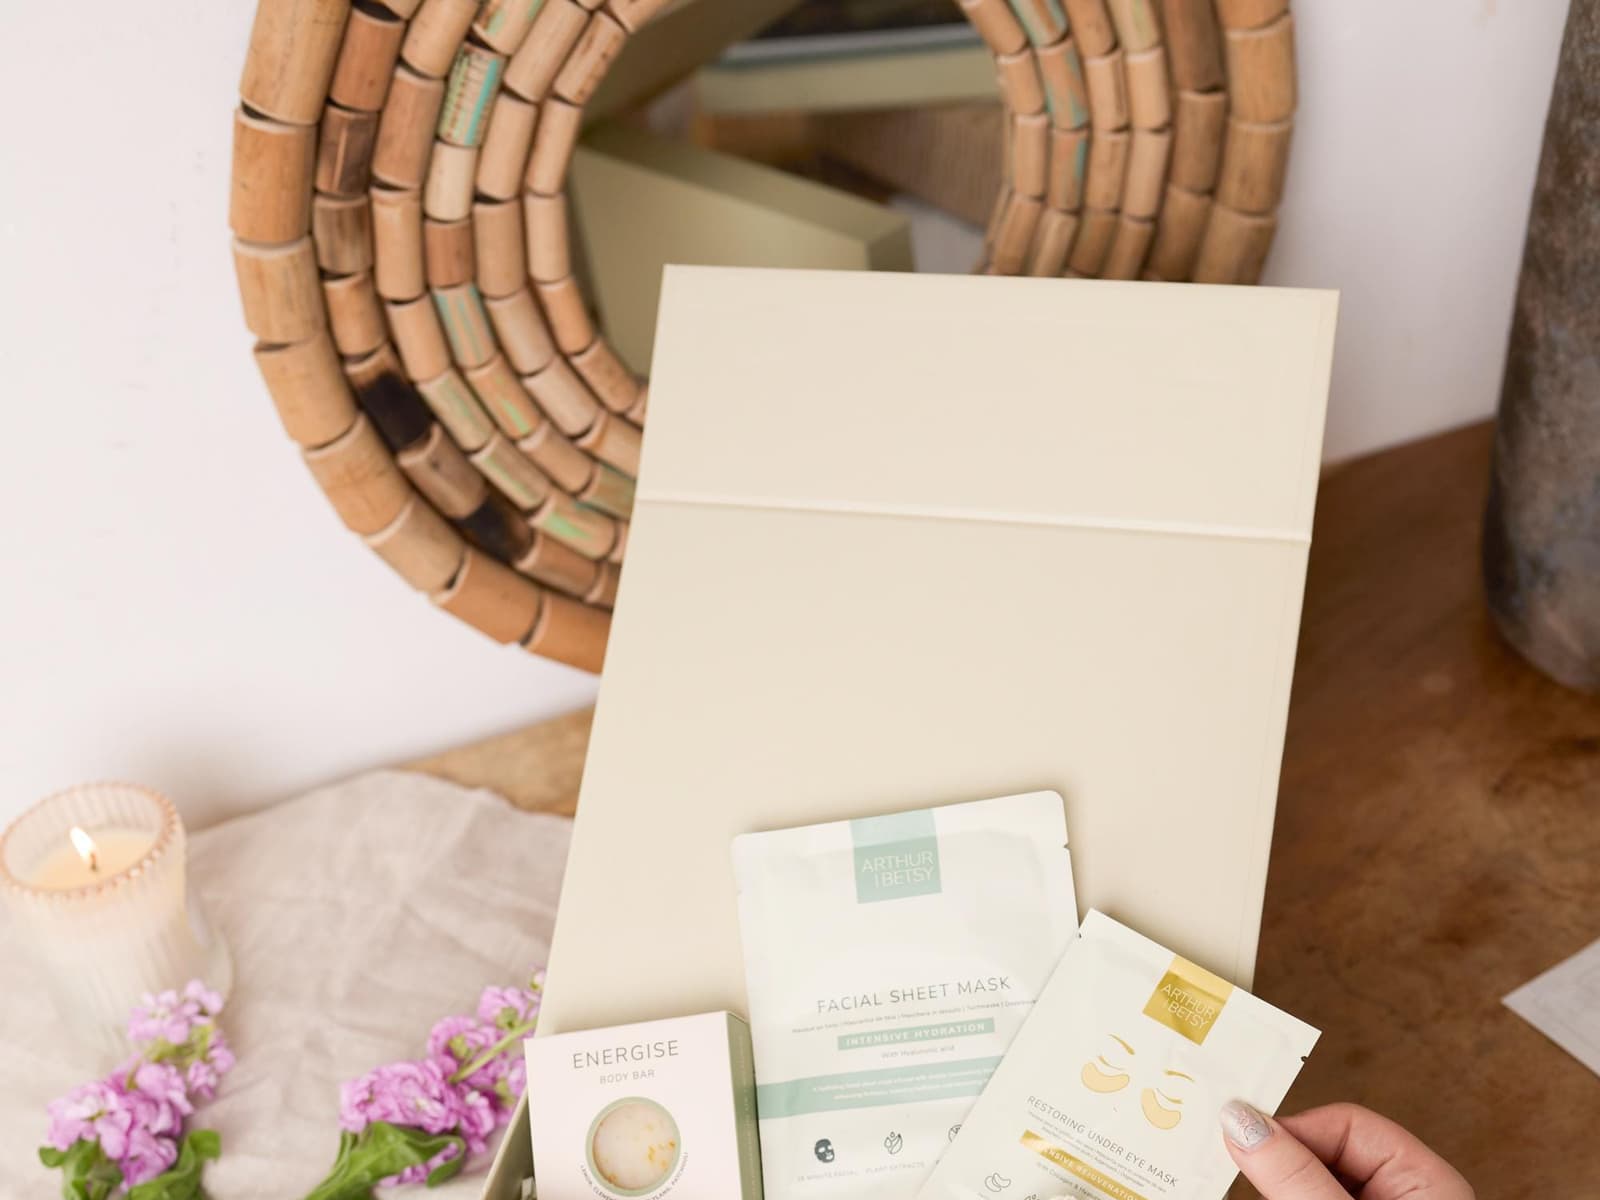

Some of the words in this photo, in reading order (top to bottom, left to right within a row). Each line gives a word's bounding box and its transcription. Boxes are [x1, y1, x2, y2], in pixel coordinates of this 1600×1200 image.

[862, 851, 934, 873] ARTHUR
[881, 866, 934, 888] BETSY
[816, 992, 884, 1014] FACIAL
[889, 984, 949, 1004] SHEET
[957, 976, 1011, 996] MASK
[1160, 984, 1216, 1019] ARTHUR
[1167, 1001, 1209, 1029] BETSY
[846, 1030, 908, 1047] INTENSIVE
[914, 1023, 985, 1040] HYDRATION
[573, 1040, 679, 1069] ENERGISE
[599, 1072, 629, 1085] BODY
[632, 1069, 656, 1081] BAR
[1027, 1095, 1086, 1134] RESTORING
[1087, 1130, 1124, 1156] UNDER
[1125, 1151, 1146, 1169] EYE
[1147, 1164, 1179, 1188] MASK
